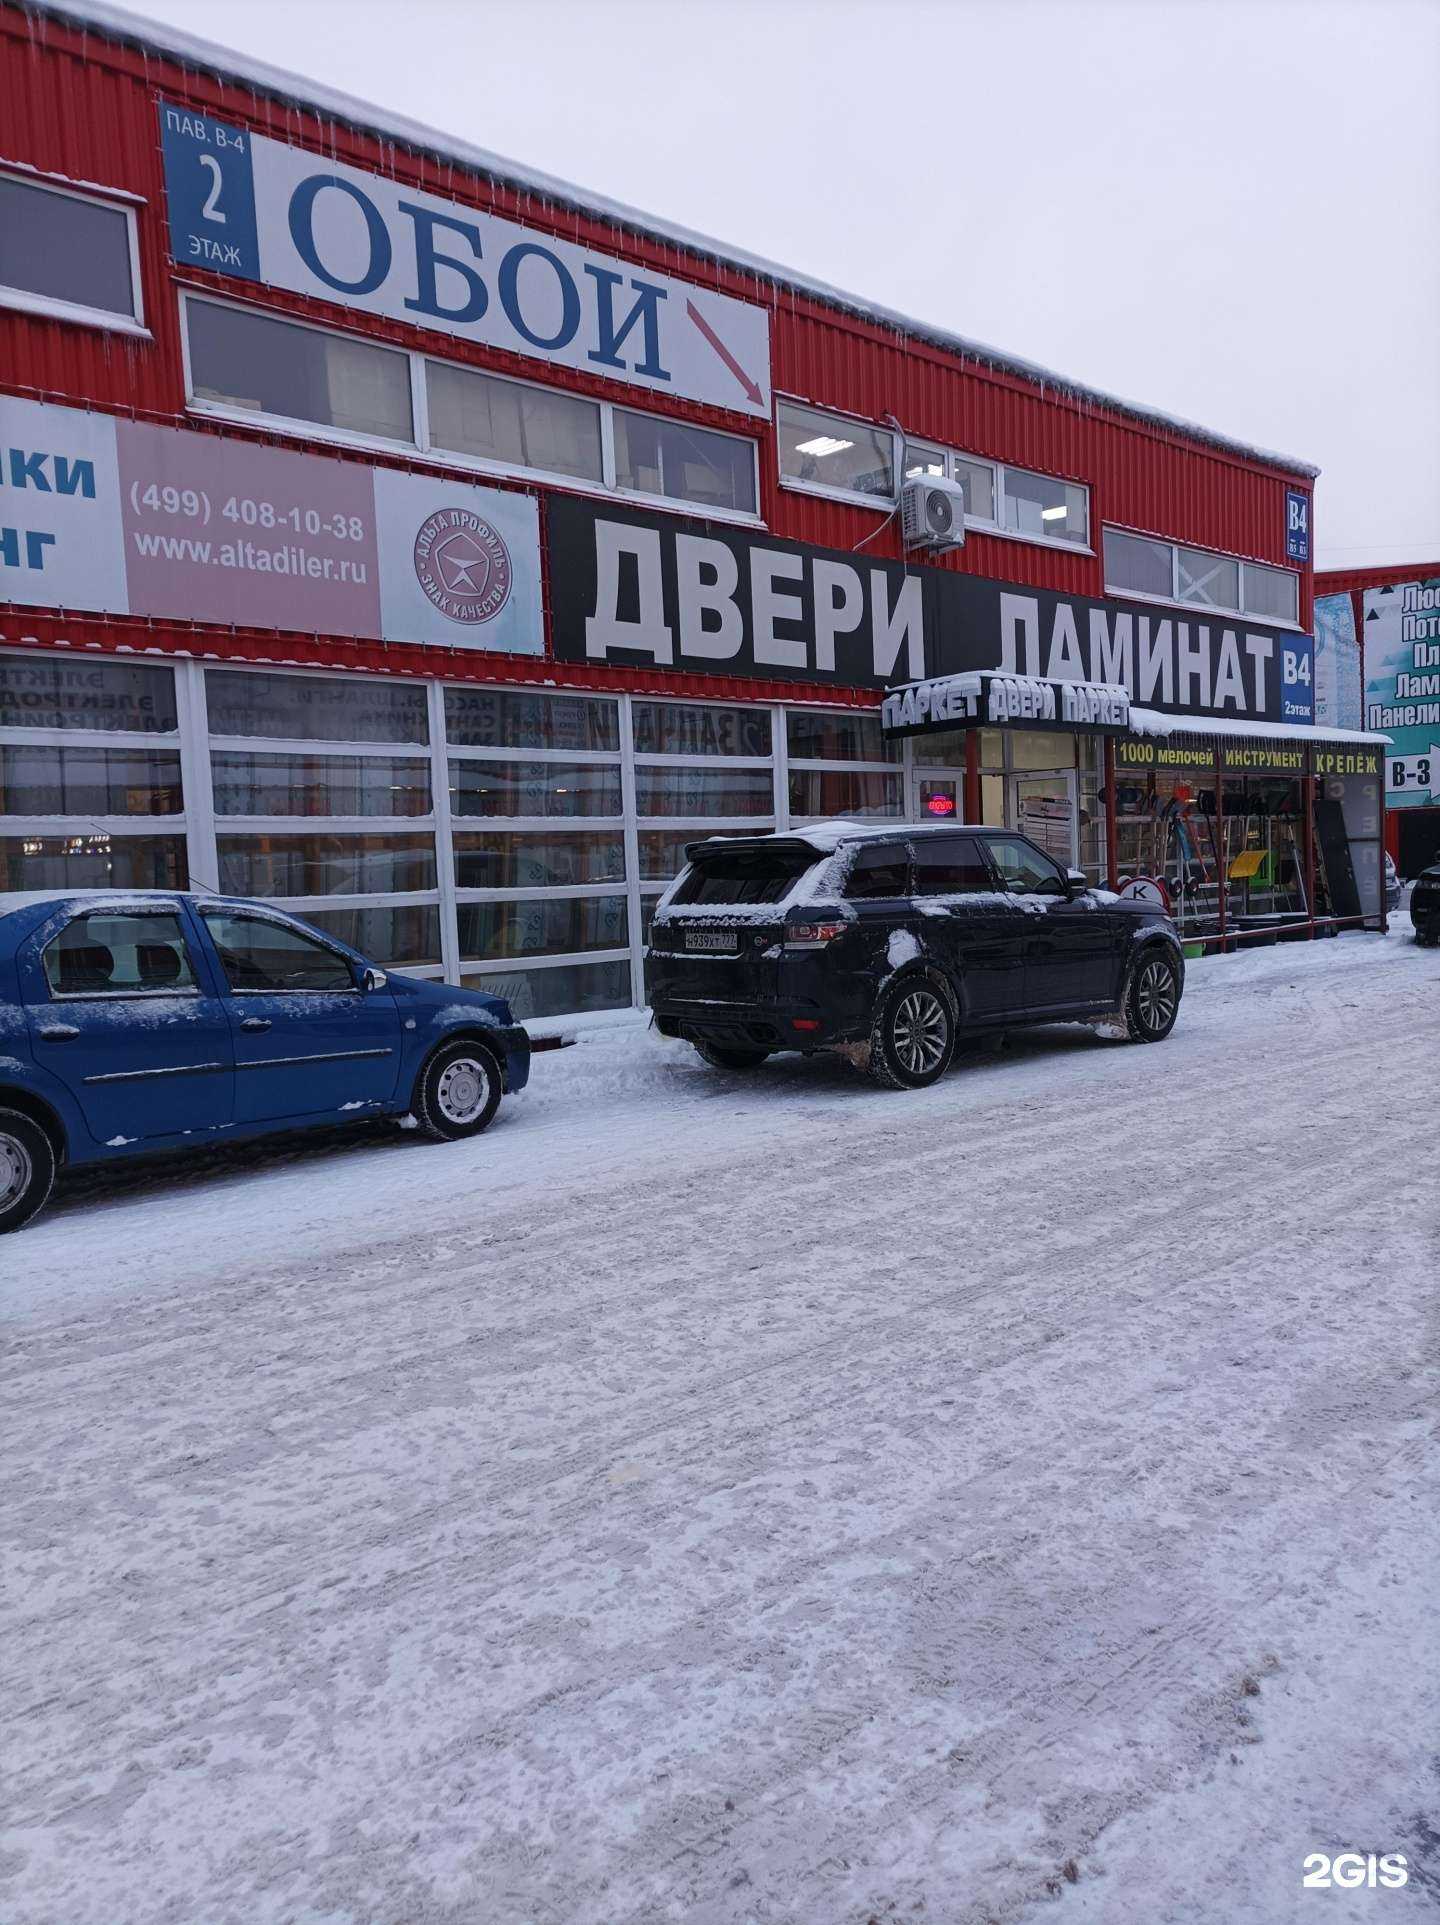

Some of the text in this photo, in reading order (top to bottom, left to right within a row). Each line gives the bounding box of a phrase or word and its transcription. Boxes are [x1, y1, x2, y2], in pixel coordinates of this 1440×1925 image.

[166, 110, 245, 154] ПАВ. В-4
[200, 154, 226, 223] 2
[188, 234, 242, 267] ЭТАЖ
[288, 174, 671, 382] ОБОИ
[0, 448, 96, 499] ки
[130, 481, 364, 541] (499) 408-10-38
[1289, 500, 1306, 533] В4
[134, 531, 367, 584] www.altadiler.ru
[417, 511, 506, 568] АЛЬТА ПРОФИЛЬ
[421, 574, 505, 618] ЗНАК КАЧЕСТВА
[585, 518, 925, 680] ДВЕРИ
[1402, 614, 1440, 641] Пот
[995, 592, 1273, 712] ЛАМИНАТ
[1283, 651, 1311, 687] В4
[882, 680, 980, 728] ПАРКЕТ
[988, 680, 1129, 725] ДВЕРИ ПАРКЕТ
[1284, 700, 1311, 717] 2этаж
[1120, 742, 1214, 766] 1000 мелочей
[1226, 749, 1304, 768] ИНСТРУМЕНТ
[1316, 753, 1376, 773] КРЕПЁЖ
[1392, 758, 1431, 786] В-3
